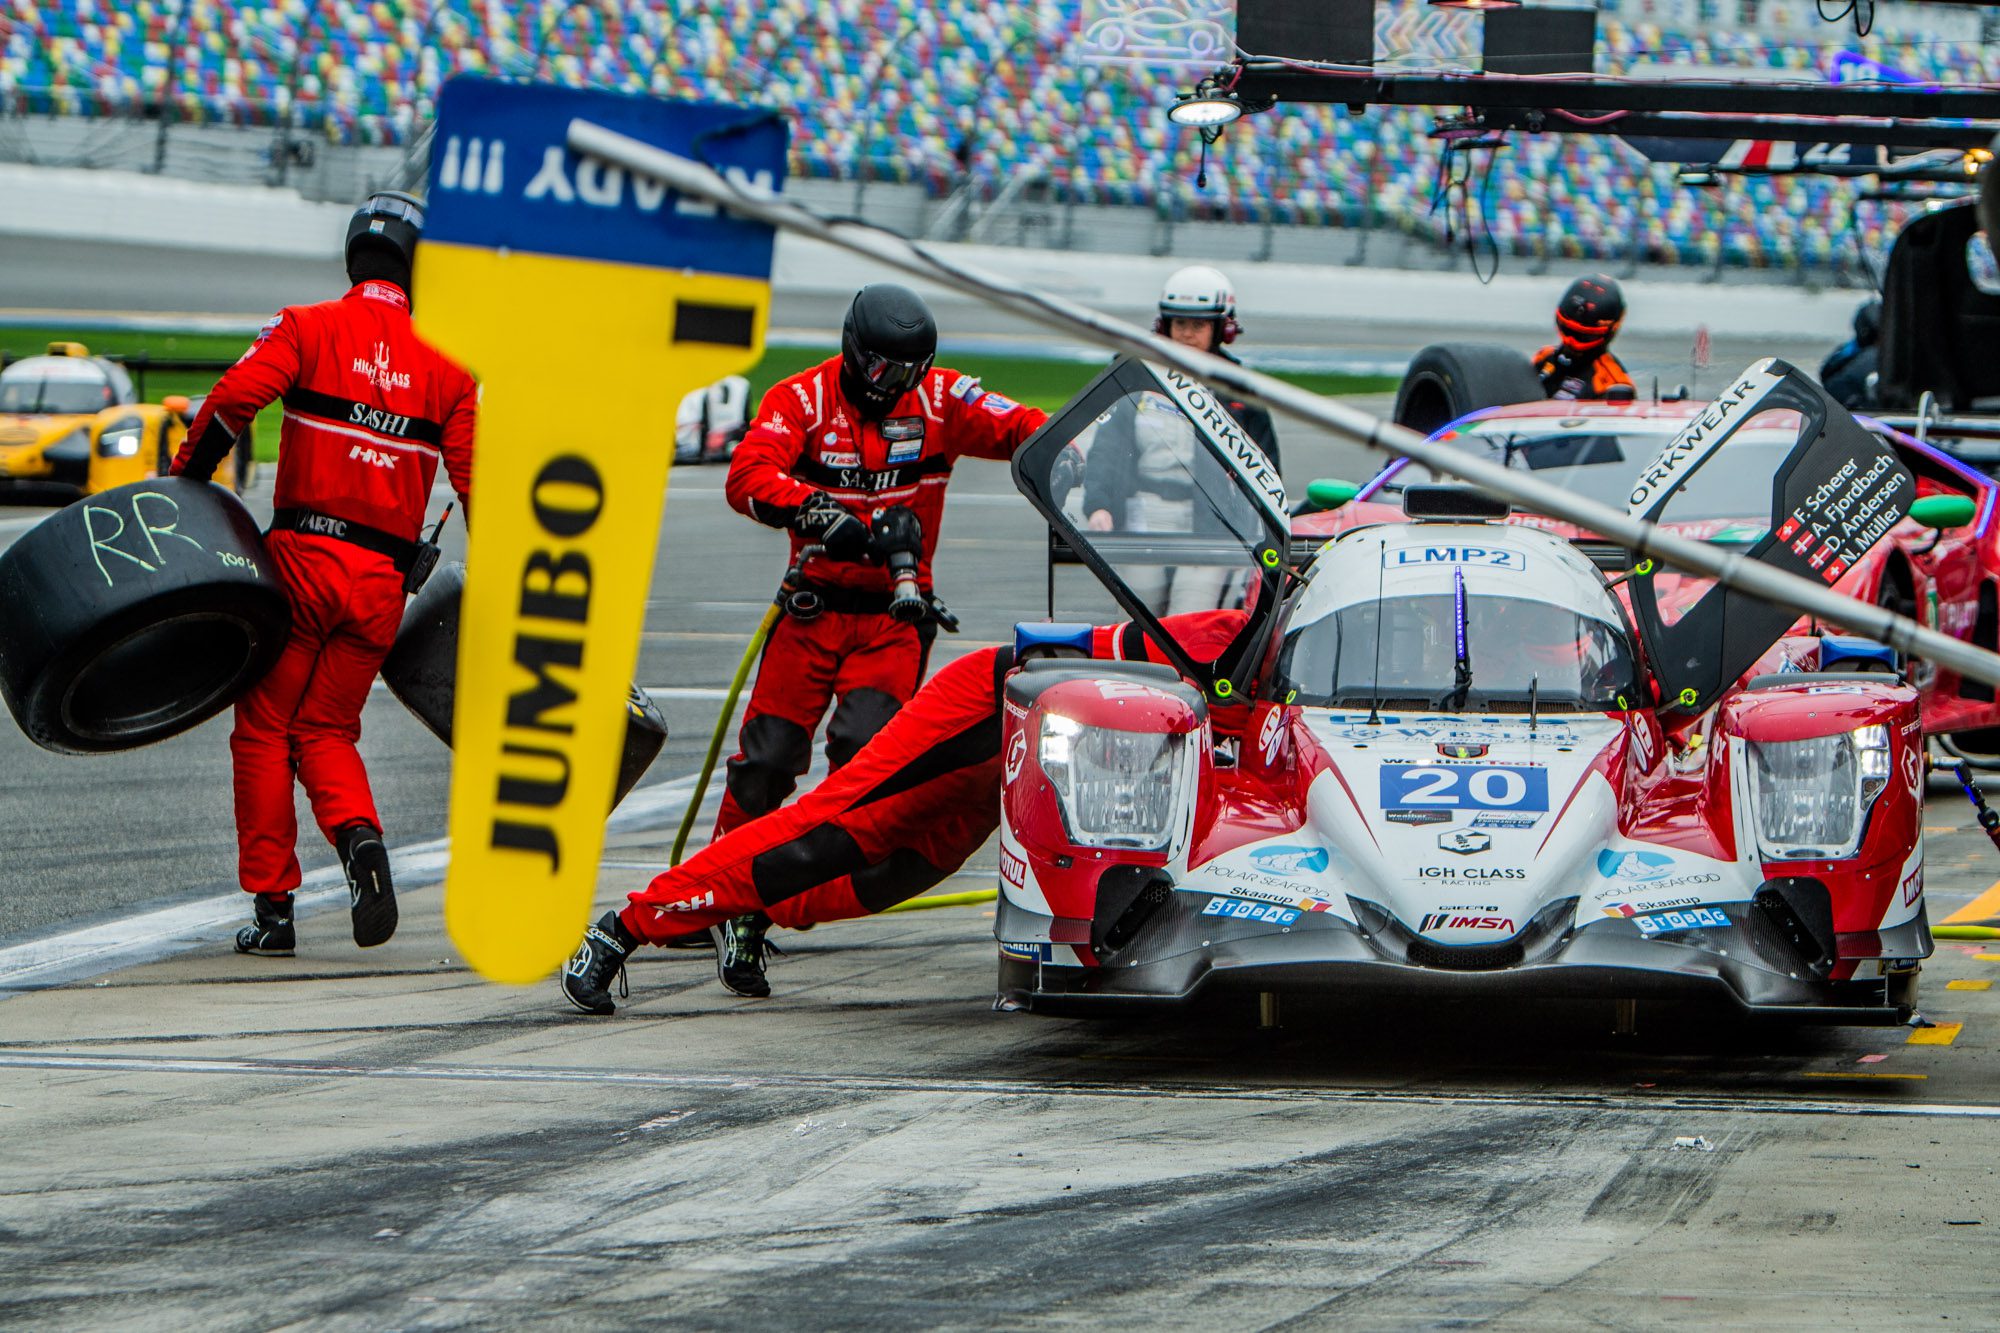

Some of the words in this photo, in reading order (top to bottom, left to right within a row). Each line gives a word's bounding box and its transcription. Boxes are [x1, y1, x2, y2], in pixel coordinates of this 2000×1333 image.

[349, 402, 411, 437] SASHI
[1167, 367, 1291, 517] WORKWEA
[1629, 379, 1757, 506] ORKWEAR
[349, 445, 400, 470] HRX
[839, 469, 901, 492] SAHI
[1793, 507, 1811, 524] F.
[1805, 458, 1859, 512] Scherer
[1811, 522, 1831, 539] A.
[1824, 454, 1894, 523] Fjordbach
[1824, 535, 1846, 554] D.
[1841, 472, 1907, 538] Andersen
[83, 491, 206, 587] RR
[1839, 548, 1861, 567] N.
[1855, 504, 1901, 551] Müller
[1399, 547, 1511, 566] LMP2
[489, 453, 605, 877] JUMBO
[1383, 758, 1547, 767] WetherTech
[1400, 767, 1527, 806] 20
[1204, 865, 1259, 882] POLAR
[1260, 875, 1330, 898] SEAFOOD
[1420, 867, 1456, 878] IGH
[1463, 868, 1526, 879] CLASS
[1651, 872, 1721, 890] SEAFOOD
[1230, 887, 1294, 904] Skaarup
[1637, 896, 1701, 911] Skaarup
[1209, 901, 1297, 922] STOBAG
[1448, 916, 1515, 934] IMSA
[1641, 911, 1725, 928] STOBAG
